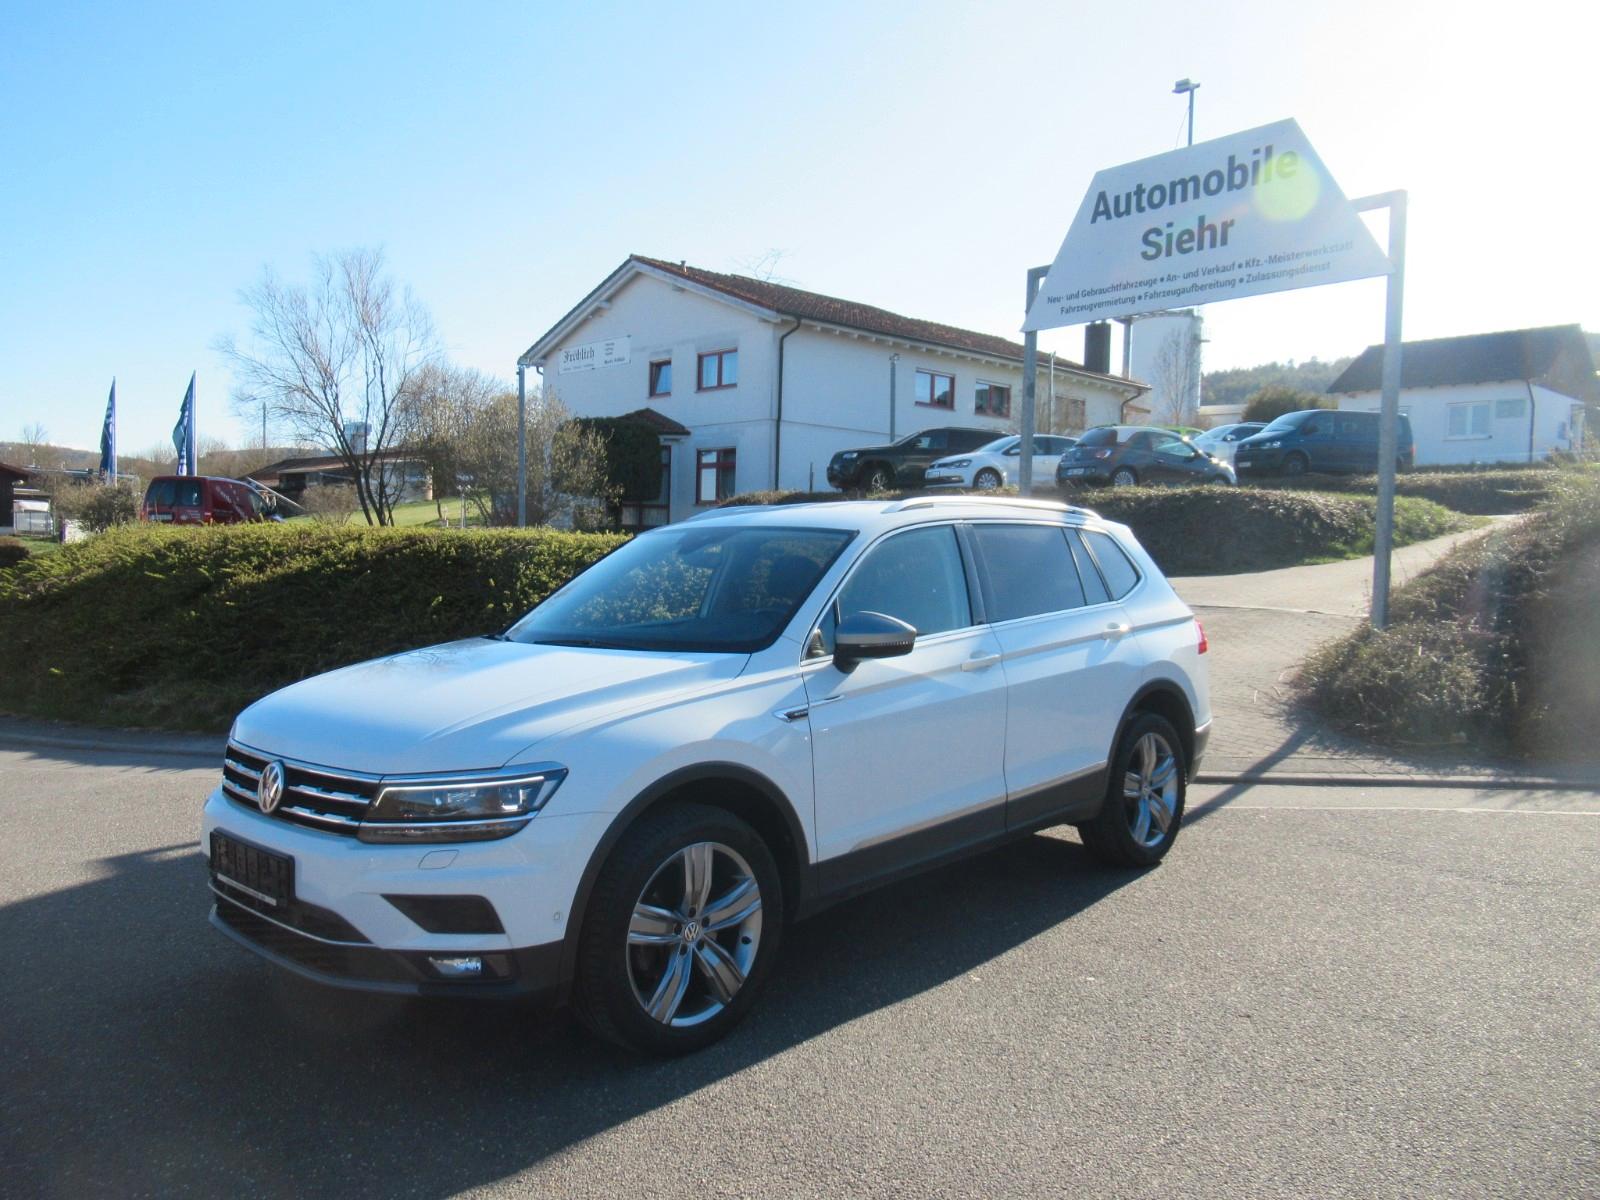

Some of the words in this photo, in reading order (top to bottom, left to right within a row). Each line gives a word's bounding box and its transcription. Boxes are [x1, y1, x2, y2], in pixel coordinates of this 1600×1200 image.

[1089, 144, 1299, 224] Automobile
[1139, 214, 1235, 261] Siehr
[1060, 294, 1136, 316] Fahrzeugvermietung
[1143, 276, 1237, 301] Fahrzeugaufbereitung
[1245, 261, 1331, 285] Zulassungsdienst
[1066, 290, 1080, 301] und
[1081, 276, 1158, 299] Gebrauchtfahrzeuge
[1166, 273, 1181, 283] An-
[1183, 268, 1200, 280] und
[1201, 261, 1236, 277] Verkauf
